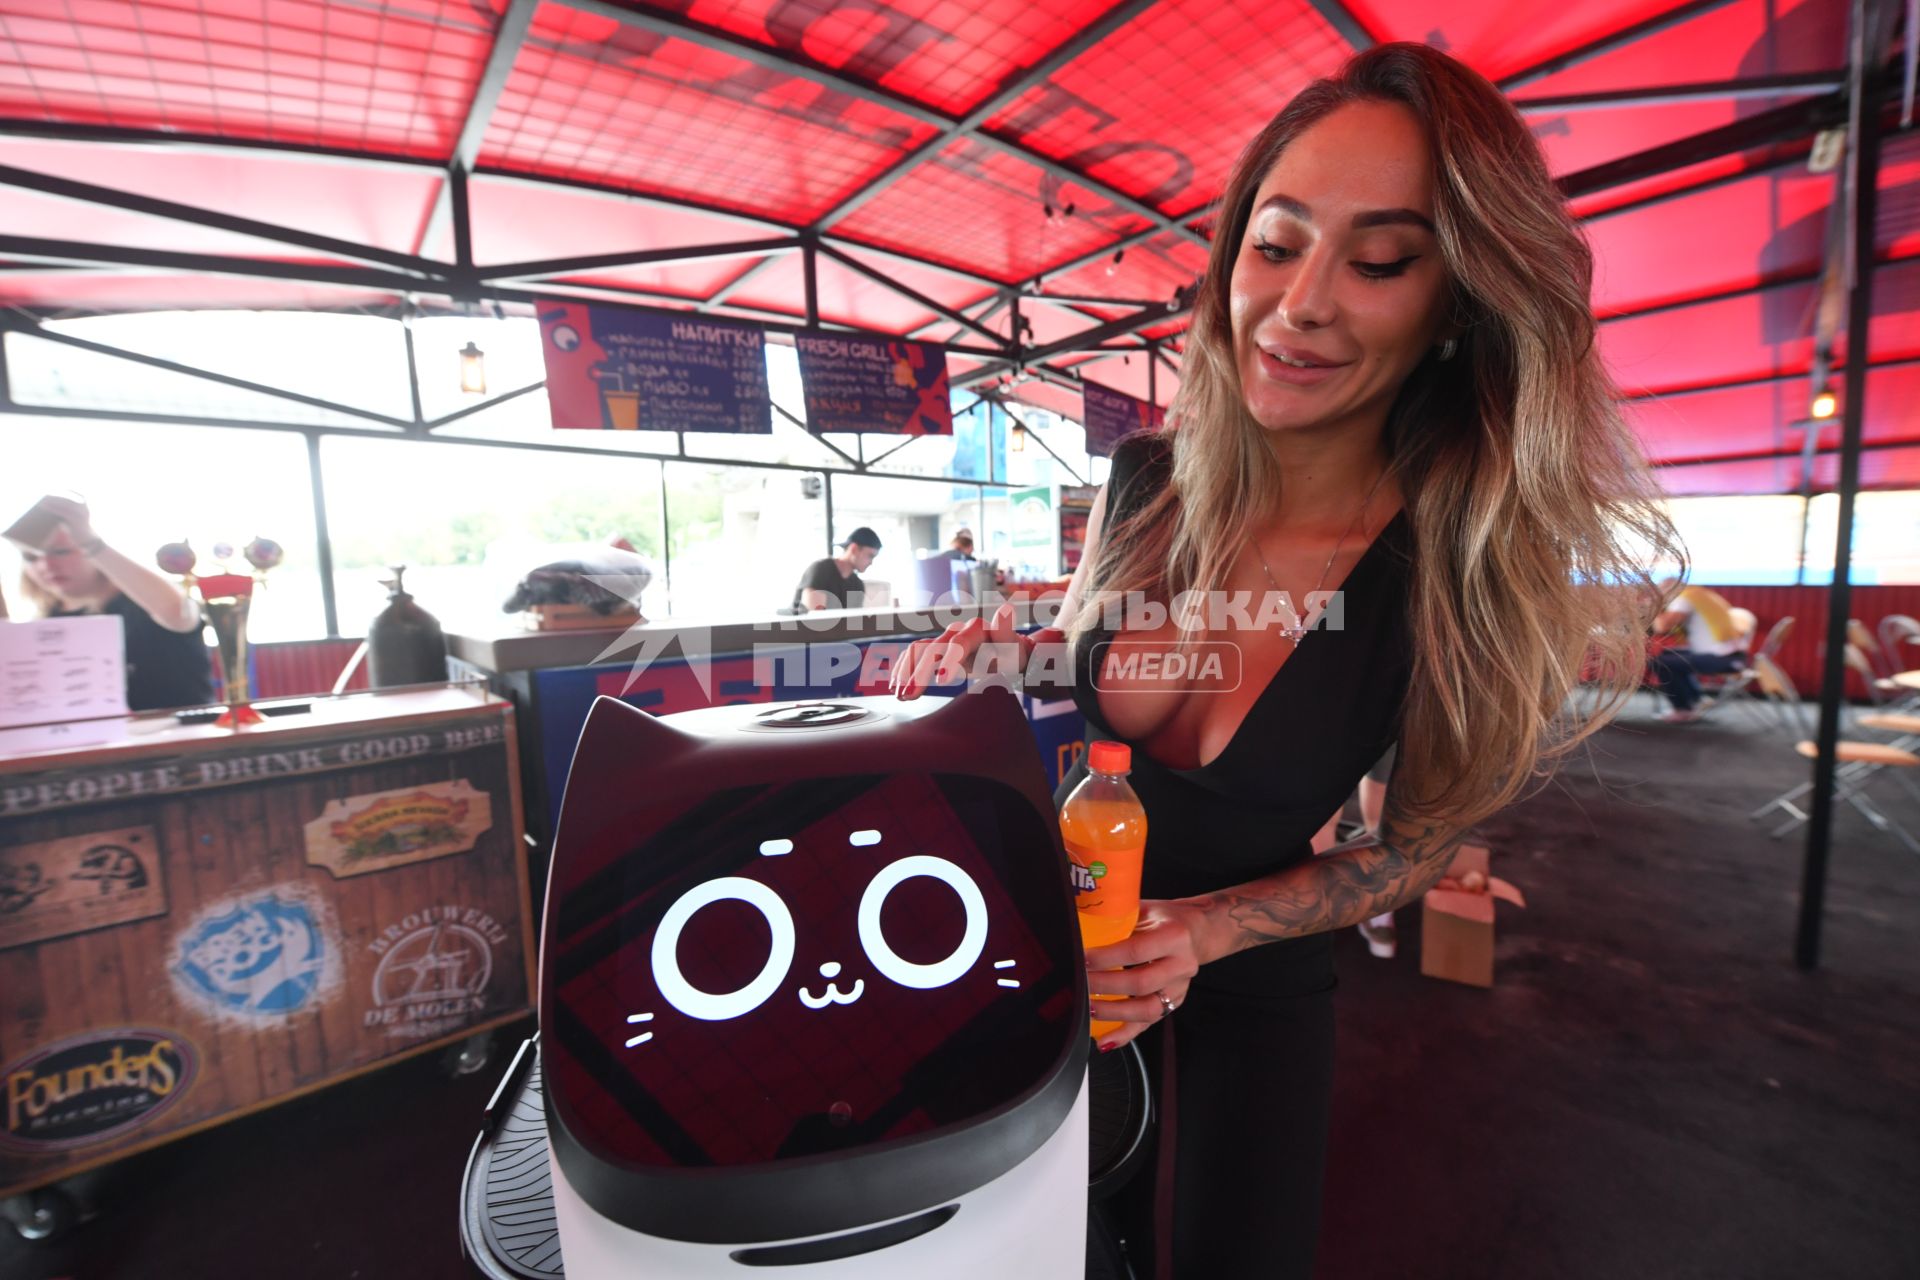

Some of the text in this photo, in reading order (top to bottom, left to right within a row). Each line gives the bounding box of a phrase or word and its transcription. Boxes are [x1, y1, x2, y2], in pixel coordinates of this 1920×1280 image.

[671, 322, 761, 348] НАПИТКИ
[798, 337, 890, 363] FRESH GRILL
[626, 363, 670, 378] ВОДА
[643, 380, 690, 396] ПИВО
[4, 724, 500, 810] PEOPLE DRINK GOOD BEE
[364, 1008, 399, 1027] DE
[405, 994, 487, 1021] MOLEN
